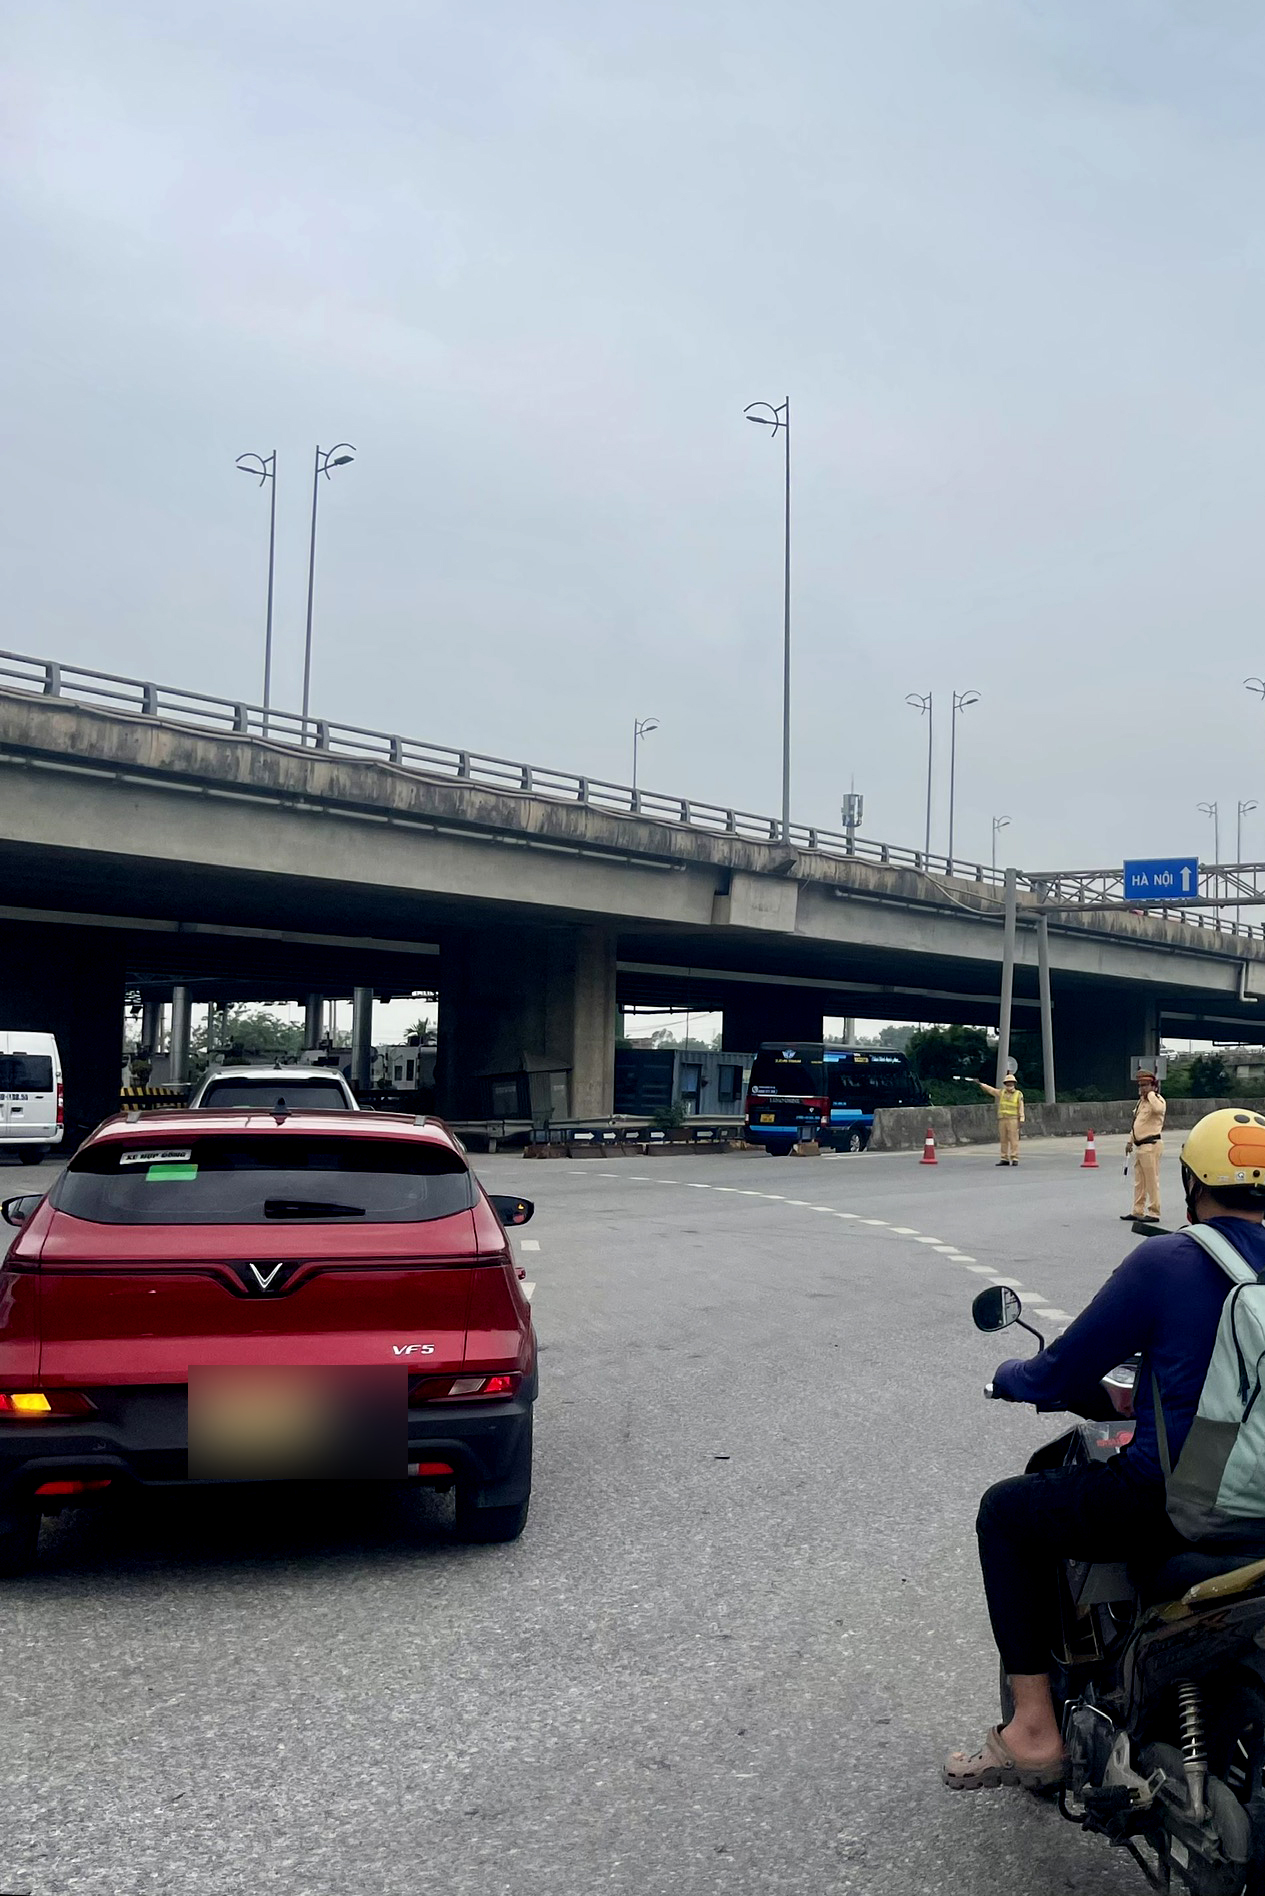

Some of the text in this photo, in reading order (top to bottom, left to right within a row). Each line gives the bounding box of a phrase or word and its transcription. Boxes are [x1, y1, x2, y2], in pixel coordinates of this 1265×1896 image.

[1131, 870, 1174, 888] HÀ NỘI
[392, 1344, 435, 1355] VF5
